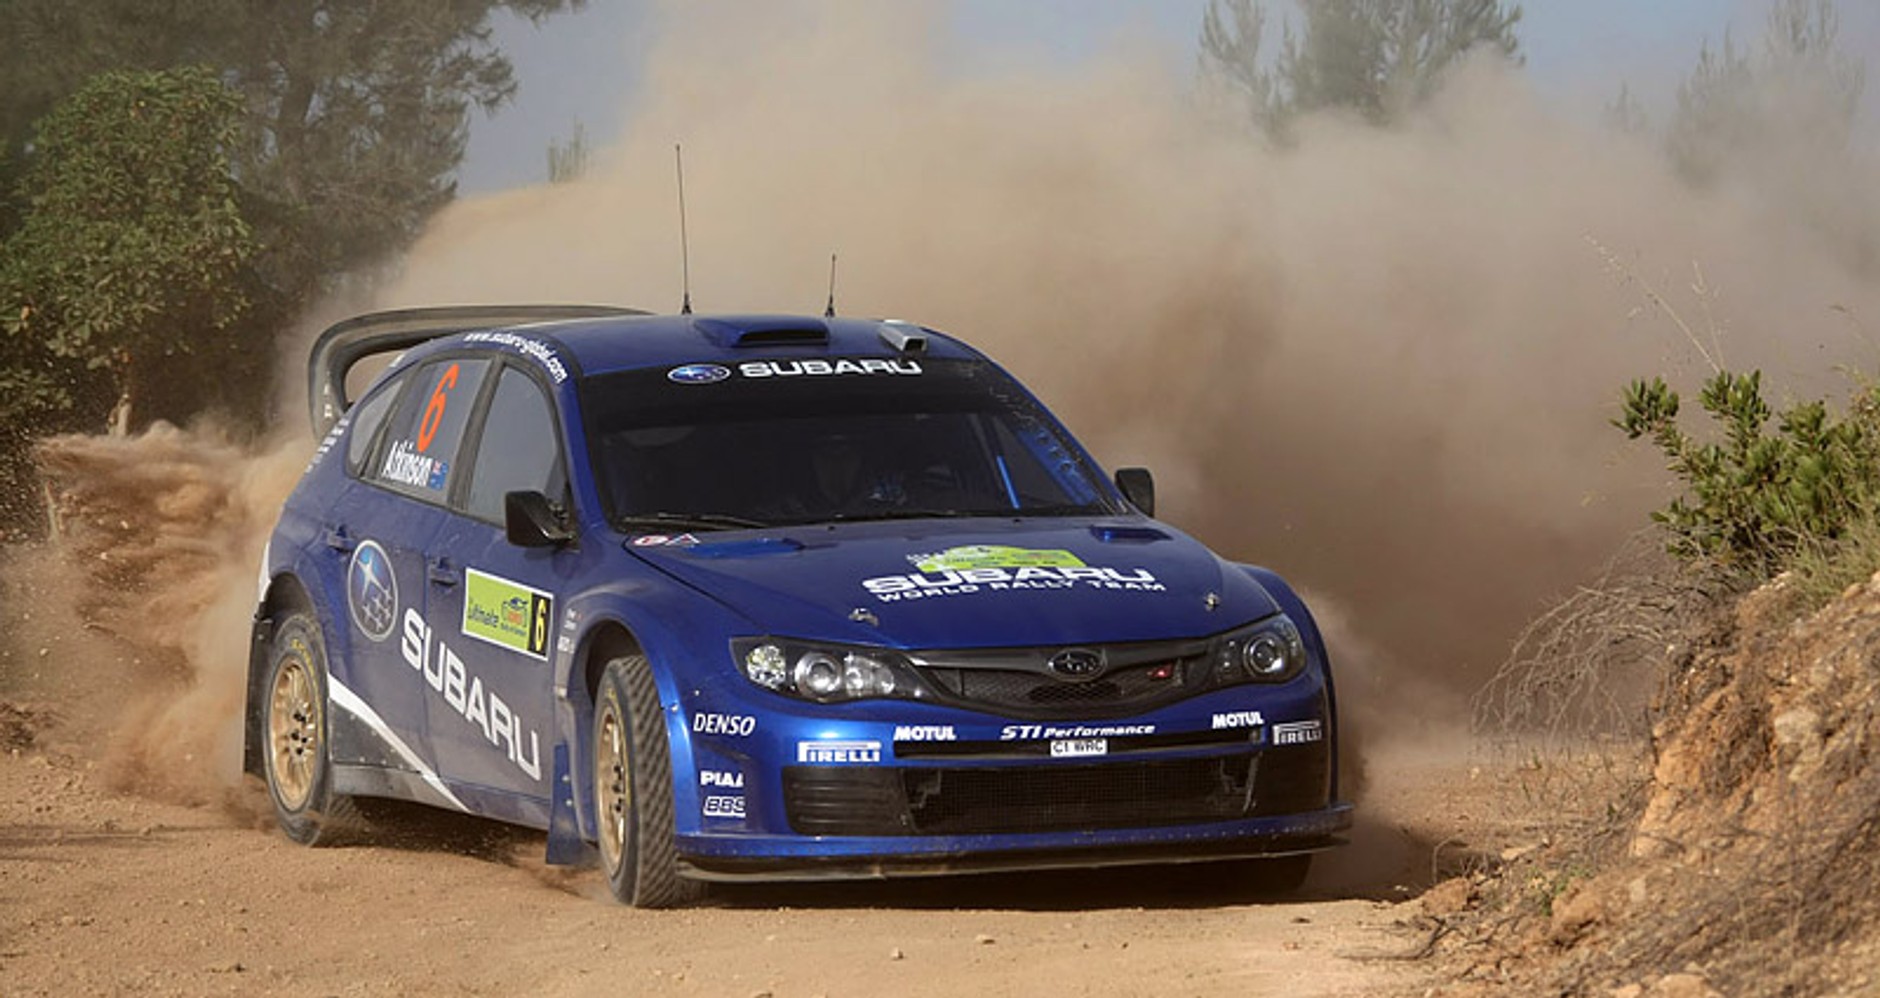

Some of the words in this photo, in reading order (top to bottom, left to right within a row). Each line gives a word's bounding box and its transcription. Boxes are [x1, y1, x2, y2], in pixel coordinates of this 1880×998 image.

[738, 359, 922, 378] SUBARU
[417, 363, 459, 452] 6
[381, 440, 433, 487] Atkinson
[862, 567, 1155, 593] SUBARU
[878, 585, 979, 602] WORLD
[990, 580, 1074, 591] RALLY
[1084, 578, 1167, 592] TEAM
[536, 599, 546, 651] 6
[402, 608, 541, 781] SUBARU
[693, 713, 756, 736] DENSO
[1212, 711, 1264, 729] MOTUL
[893, 726, 957, 741] MOTUL
[1001, 726, 1042, 740] STI
[1043, 725, 1156, 739] Performance
[1272, 720, 1322, 745] PIRELLI
[798, 741, 882, 762] PIRELLI
